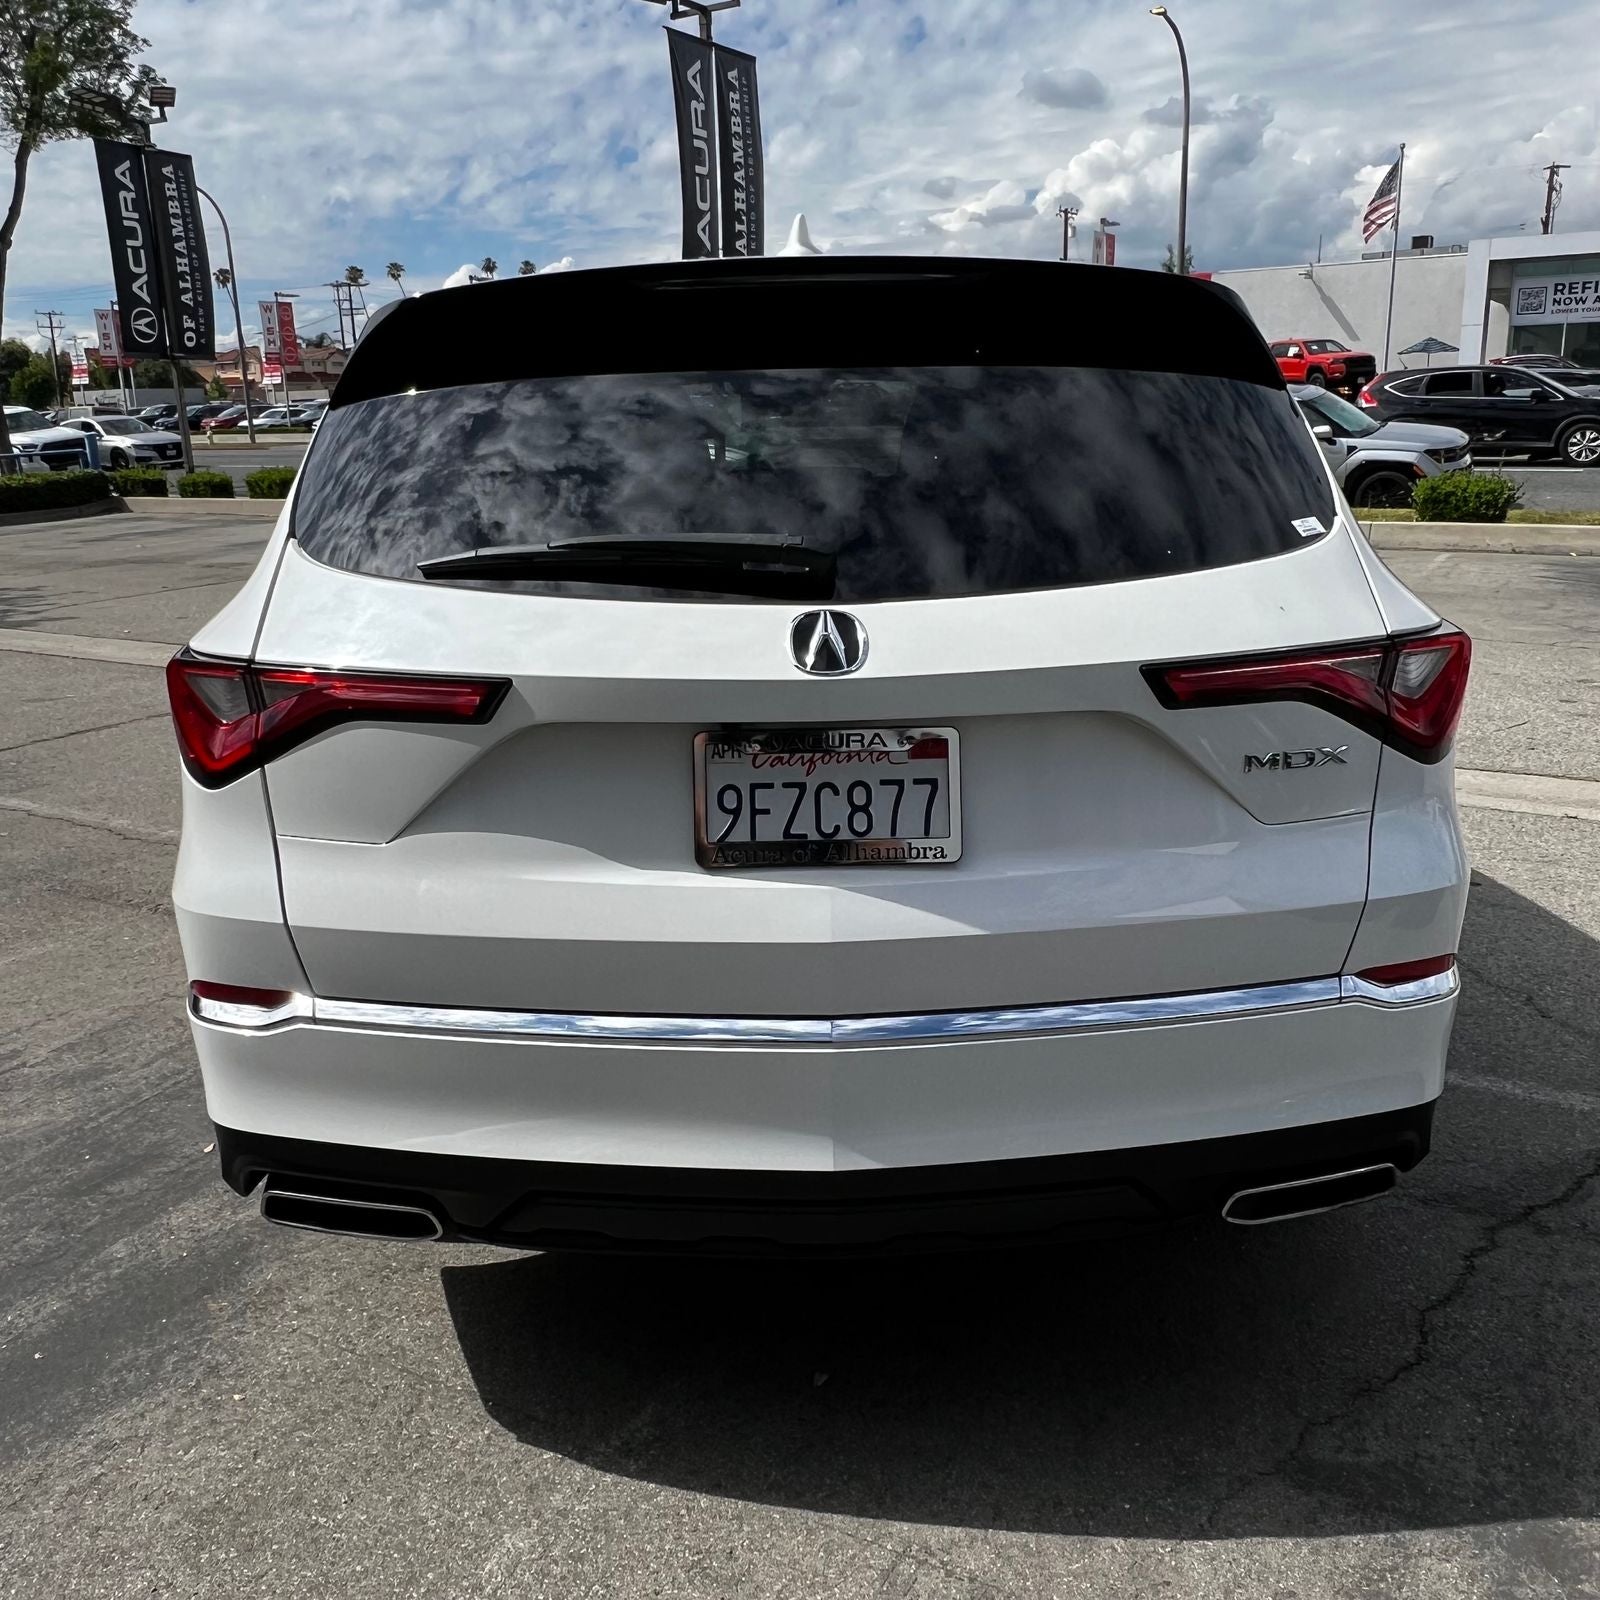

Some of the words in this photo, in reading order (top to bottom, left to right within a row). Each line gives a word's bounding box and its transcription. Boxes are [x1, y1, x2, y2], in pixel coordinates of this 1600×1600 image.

[686, 59, 712, 252] ACURA
[727, 67, 748, 257] ALHAMBRA
[114, 160, 152, 305] ACURA
[161, 164, 194, 307] ALHAMBRA
[1552, 296, 1589, 307] NOW
[97, 311, 112, 351] WISH
[183, 315, 197, 348] OF
[262, 304, 277, 347] WISH
[784, 732, 889, 750] ACURA
[1243, 744, 1350, 774] MDX
[750, 750, 908, 778] California
[716, 777, 940, 844] 9FZC877
[711, 845, 786, 866] Acura
[824, 841, 948, 862] Alhambra
